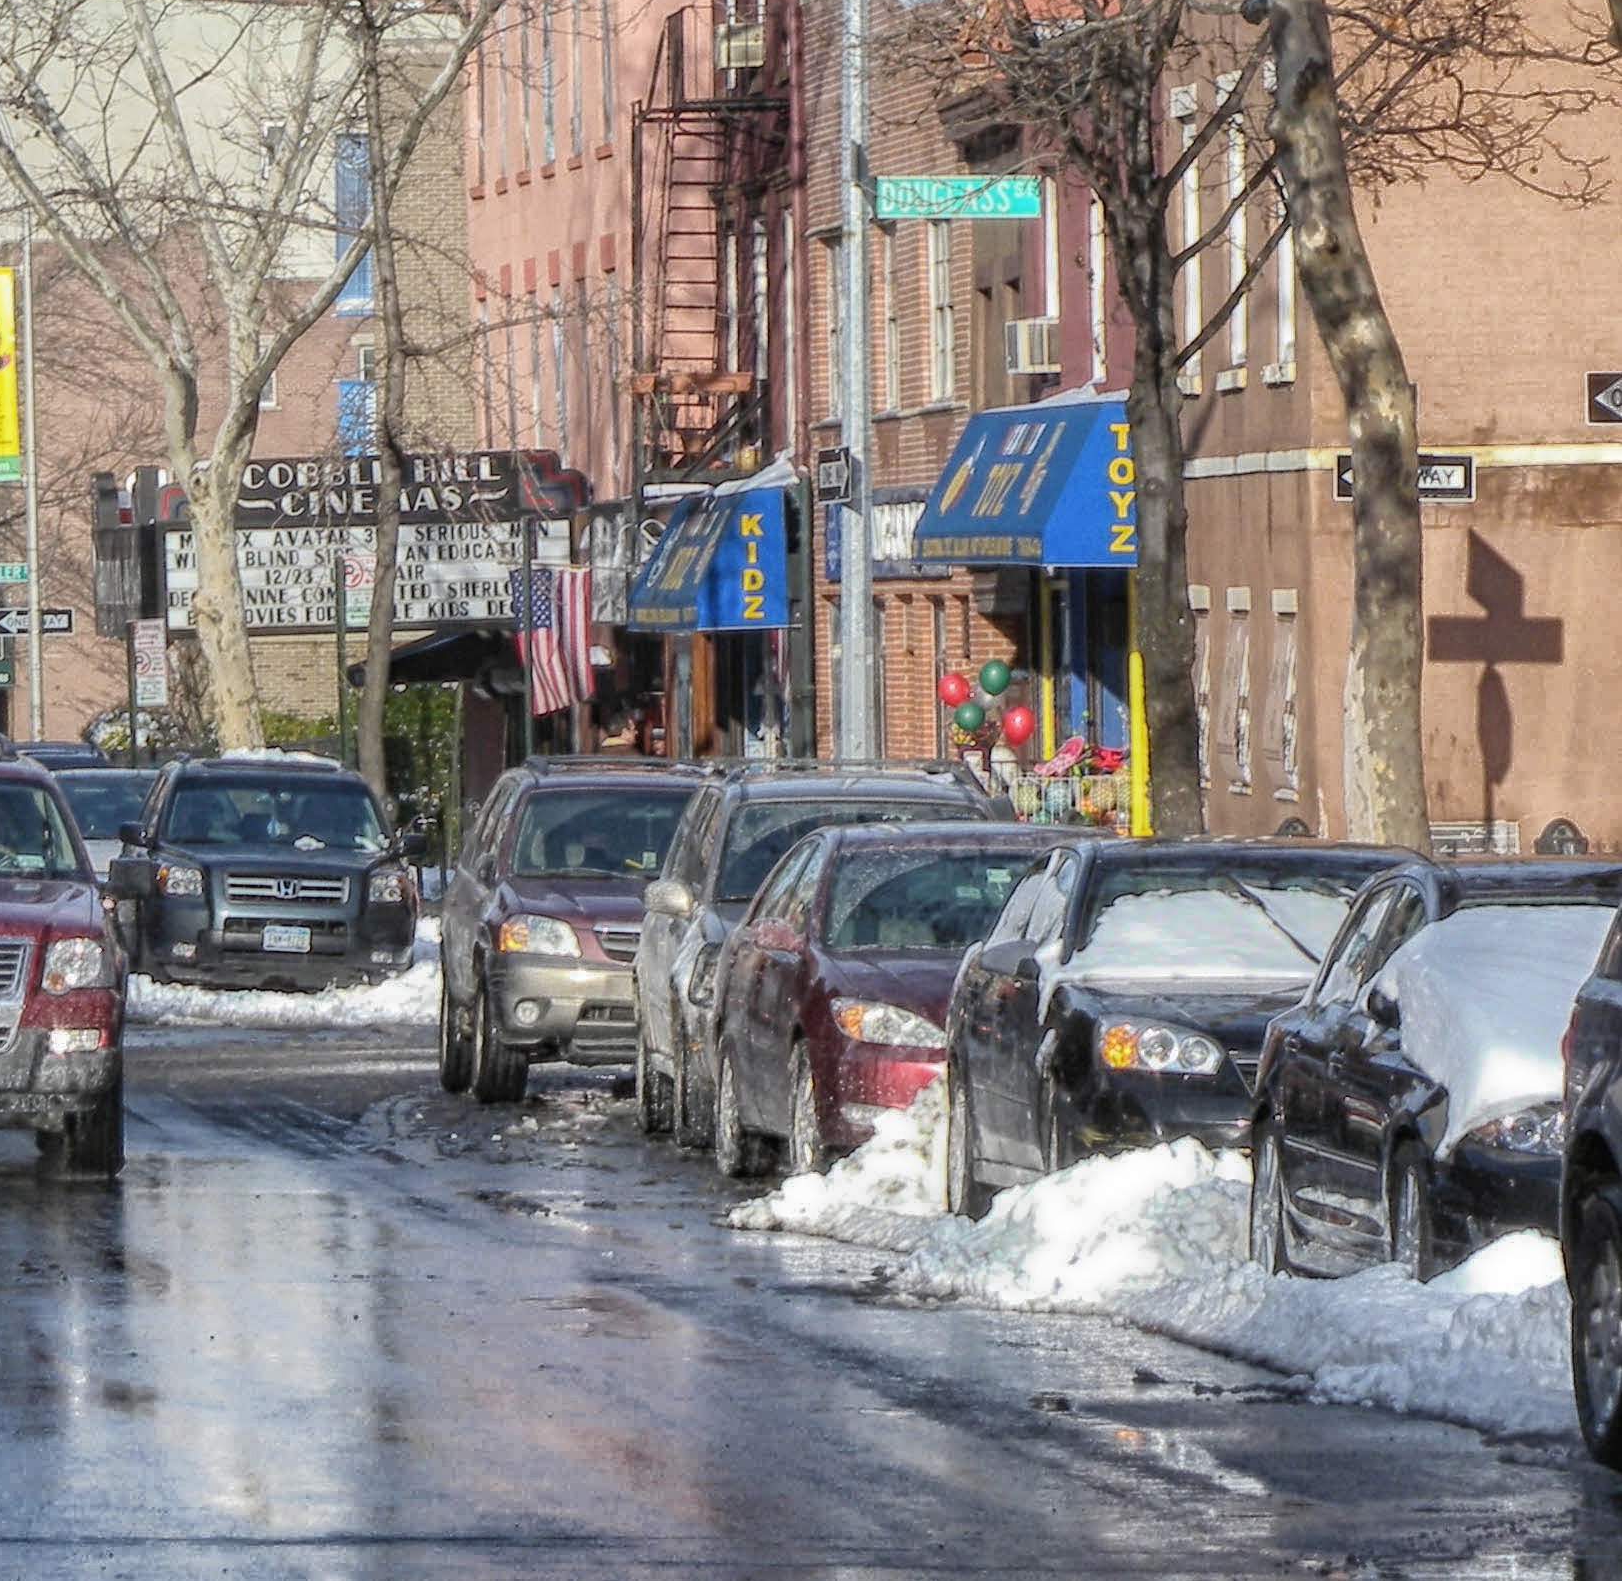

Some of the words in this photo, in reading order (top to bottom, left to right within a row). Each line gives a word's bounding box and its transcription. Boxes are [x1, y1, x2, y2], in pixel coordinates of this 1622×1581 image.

[1109, 423, 1136, 552] TOYZ
[281, 486, 463, 517] CINEAS
[273, 528, 349, 546] AVATAR
[415, 523, 489, 541] SERIOUS
[245, 550, 298, 567] BLIND
[406, 544, 428, 560] AN
[265, 569, 312, 585] 12/23
[739, 514, 765, 619] KIDZ
[246, 589, 287, 605] NINE
[244, 606, 297, 623] OVIES
[429, 601, 469, 618] KIDS
